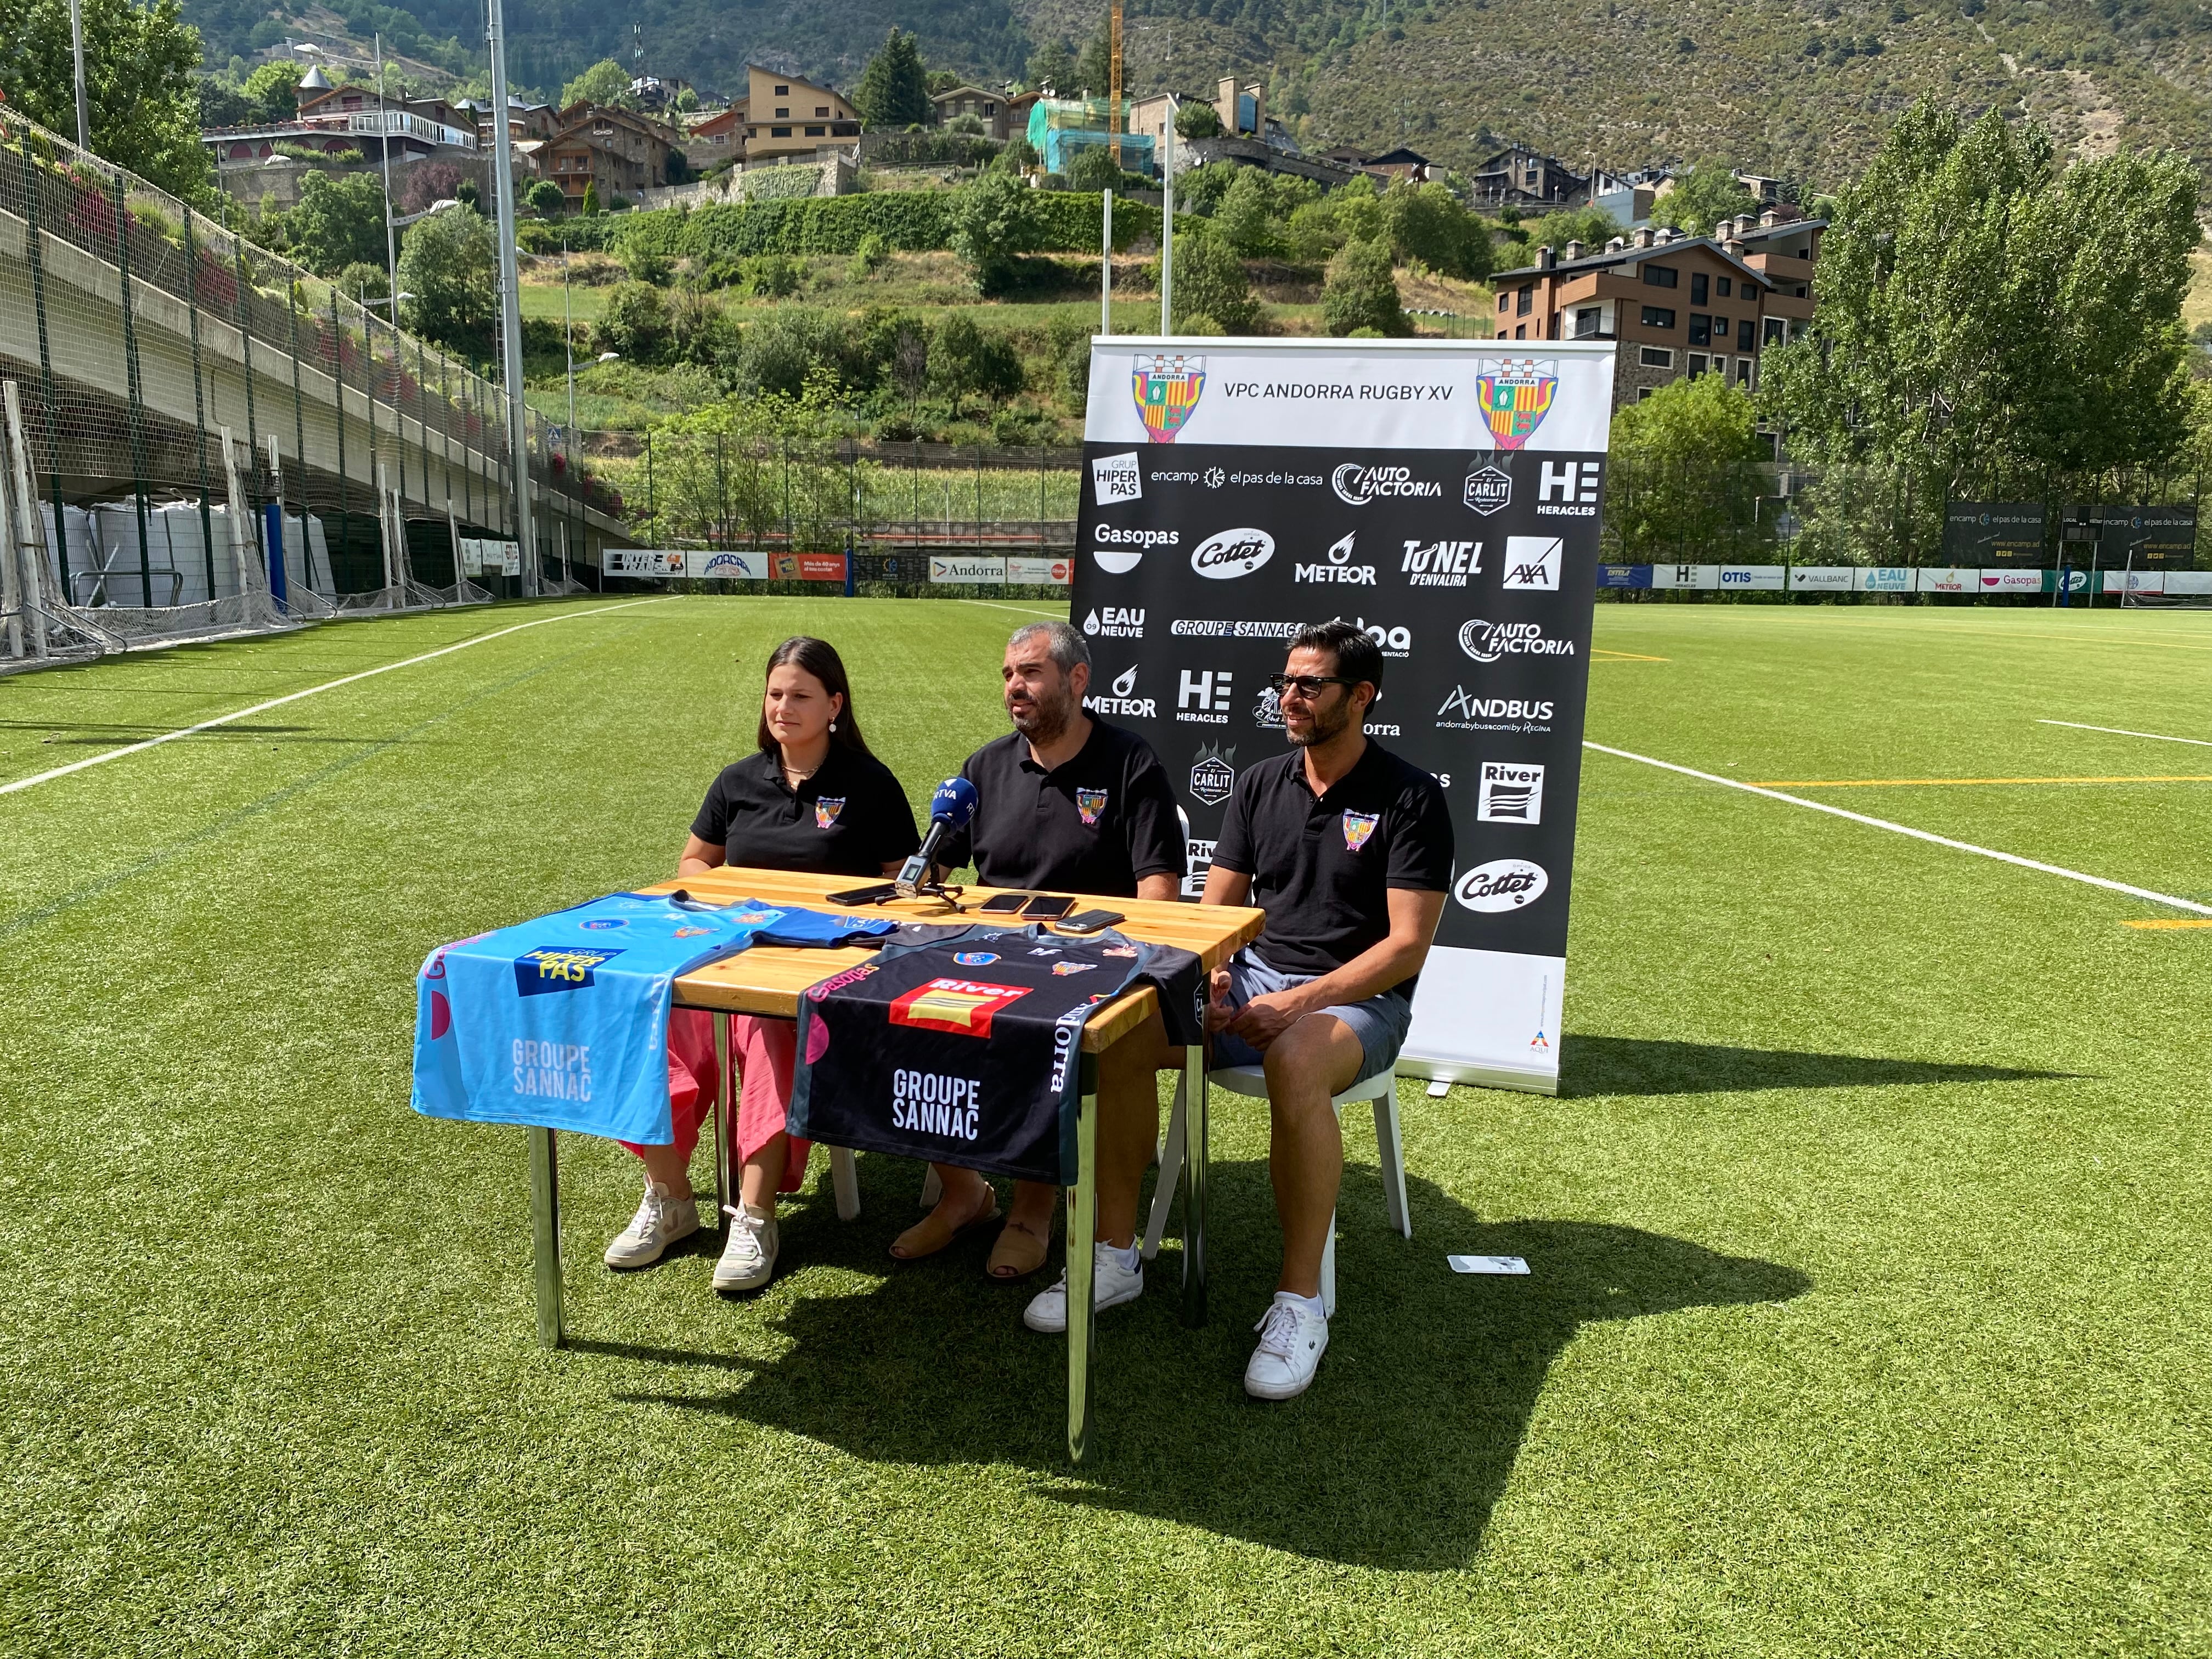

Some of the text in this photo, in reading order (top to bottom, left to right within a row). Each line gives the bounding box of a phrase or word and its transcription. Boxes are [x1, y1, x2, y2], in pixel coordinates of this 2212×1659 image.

[1224, 382, 1453, 401] VPC ANDORRA RUGBY XV
[1111, 460, 1137, 469] GRUP
[1096, 469, 1137, 483] HIPER
[1151, 471, 1323, 487] encamp el pas de la casa
[1364, 467, 1410, 482] AUTO
[1110, 482, 1137, 495] PAS
[1360, 481, 1442, 496] FACTORIA
[1468, 483, 1508, 496] CARLIT
[1537, 505, 1595, 516] HERACLES
[1949, 515, 1977, 524] encamp
[1094, 523, 1180, 549] Gasopas
[1991, 540, 2040, 549] www.encamp.ad
[1198, 539, 1266, 568] Cottet
[949, 564, 1003, 576] Andorra
[1295, 562, 1376, 586] METEOR
[1504, 563, 1549, 585] AXA
[1722, 572, 1752, 583] OTIS
[1878, 569, 1907, 582] EAU
[1409, 573, 1467, 587] D'ENVALIRA
[1808, 575, 1849, 583] VALLBANC
[1877, 582, 1906, 590] NEUVE
[2004, 575, 2041, 587] Gasopas
[1102, 607, 1146, 626] EAU
[1101, 625, 1144, 638] NEUVE
[1175, 620, 1234, 636] GROUPE
[1492, 623, 1541, 639] AUTO
[1489, 638, 1575, 656] FACTORIA
[1082, 695, 1156, 718] METEOR
[1437, 684, 1554, 720] ANDBUS
[1176, 712, 1229, 724] HERACLES
[1194, 772, 1231, 788] CARLIT
[1484, 765, 1541, 783] River
[933, 789, 956, 801] RTVA
[1188, 842, 1214, 858] Riv
[1461, 871, 1538, 900] Cottet
[523, 950, 606, 966] HIPER
[568, 949, 618, 957] GRUP
[539, 961, 591, 982] PAS
[806, 962, 880, 1003] Gasopas
[928, 979, 1025, 997] River
[512, 1039, 591, 1073] GROUPE
[1530, 1046, 1549, 1054] AQUI
[513, 1066, 592, 1103] SANNAC
[893, 1068, 980, 1110] GROUPE
[892, 1098, 979, 1141] SANNAC
